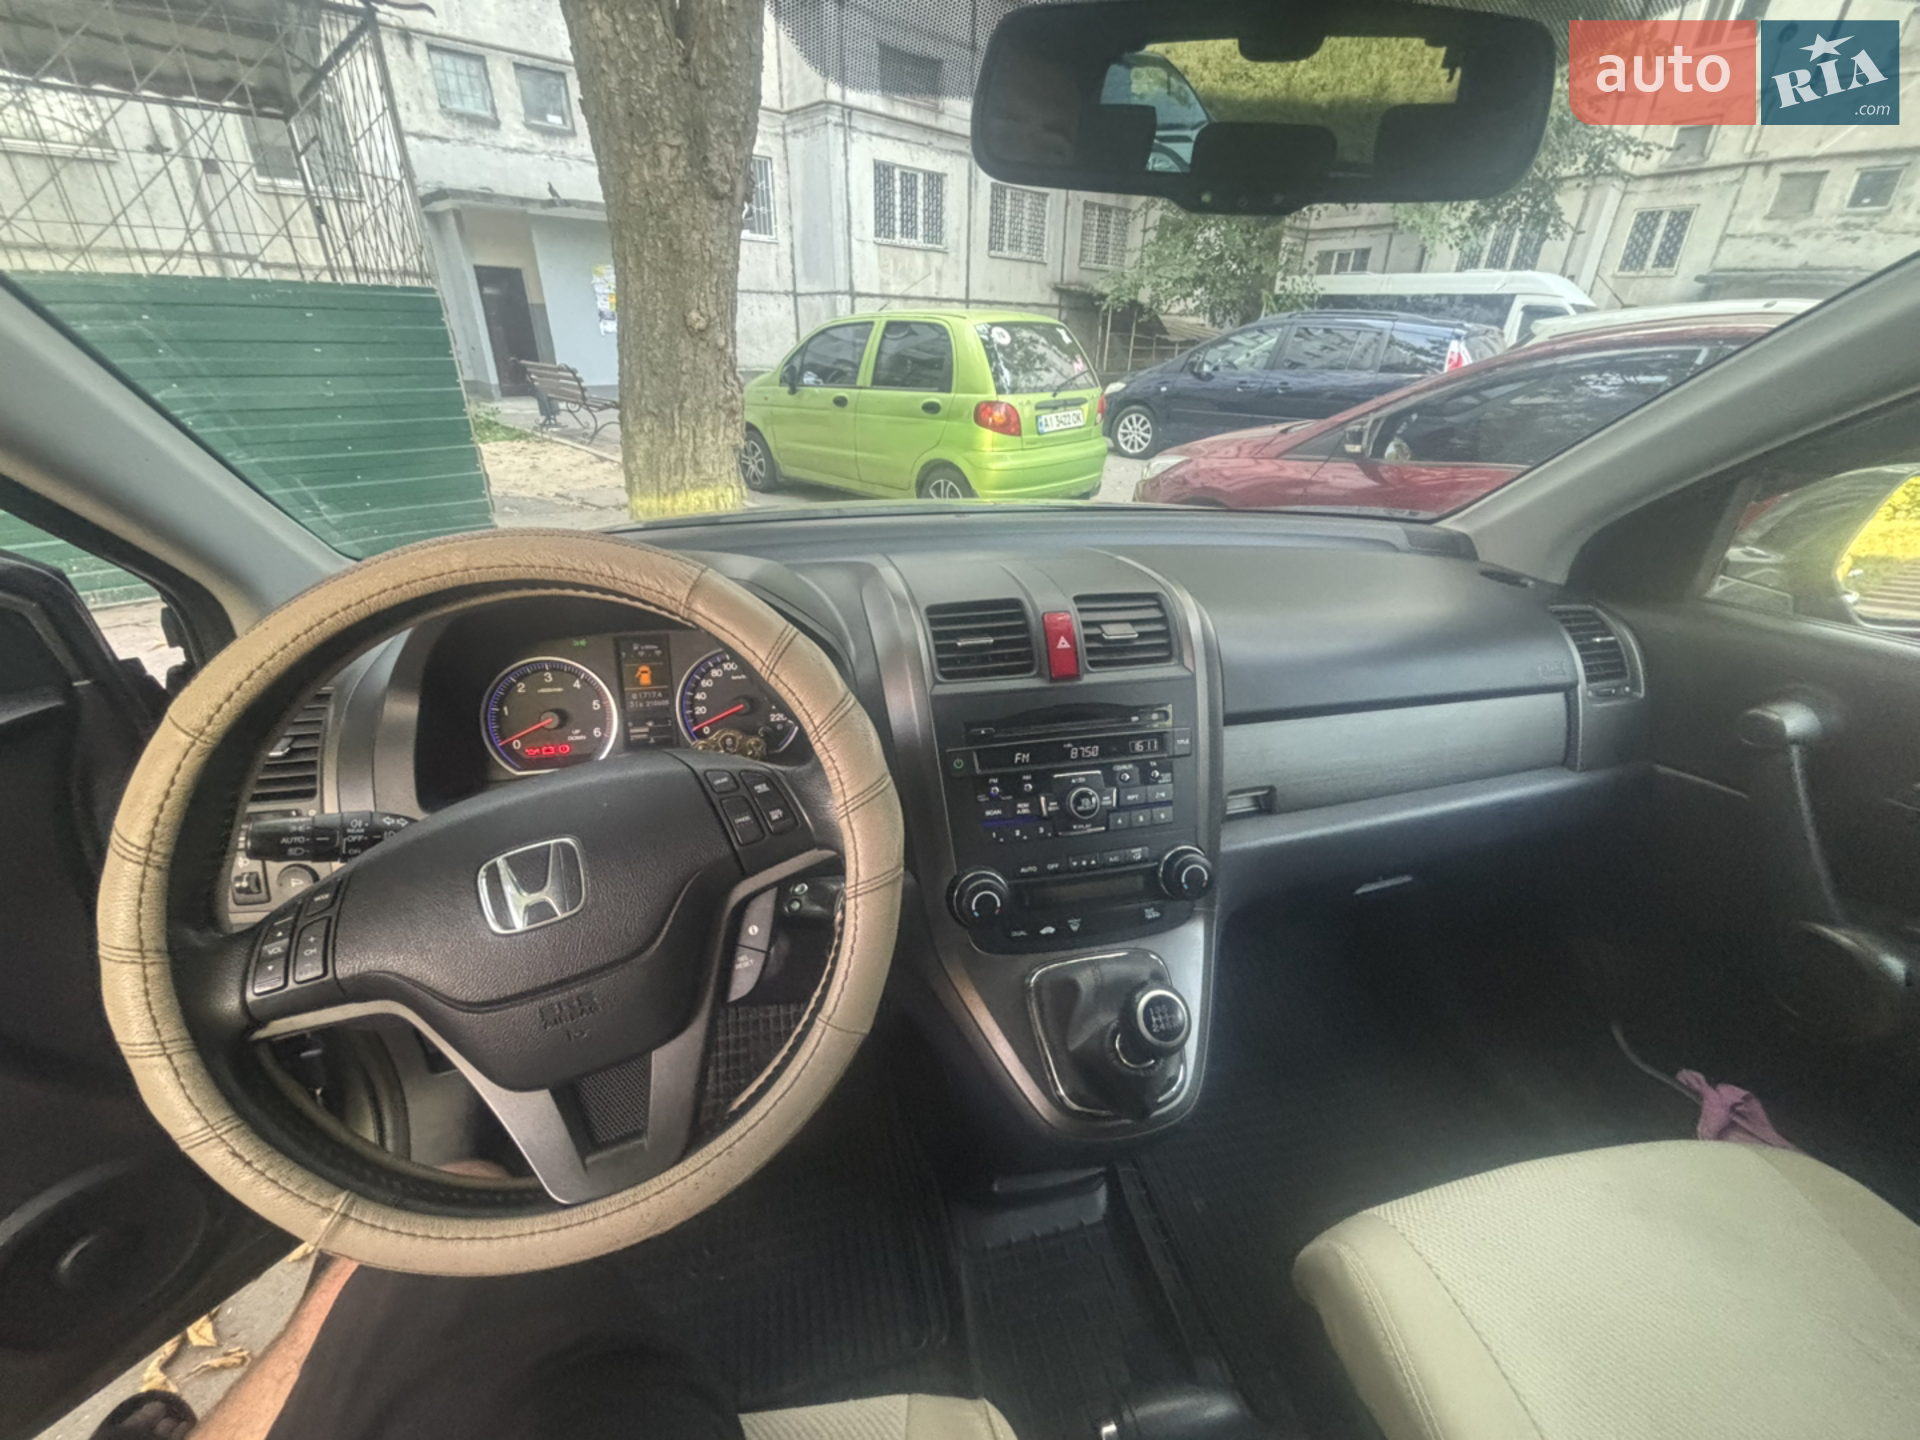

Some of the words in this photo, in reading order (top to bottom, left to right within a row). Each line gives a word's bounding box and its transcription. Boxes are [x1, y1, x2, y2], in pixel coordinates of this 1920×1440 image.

[722, 662, 738, 671] 100
[543, 671, 553, 683] 3
[710, 668, 723, 677] 80
[516, 682, 526, 693] 2
[572, 679, 581, 689] 4
[700, 678, 713, 687] 60
[694, 691, 707, 700] 40
[592, 699, 601, 710] 5
[503, 705, 509, 716] 1
[694, 706, 707, 715] 20
[592, 727, 602, 738] 6
[703, 726, 711, 734] 0
[512, 739, 521, 750] 0
[1014, 752, 1030, 764] FM
[985, 809, 1002, 817] SCAN
[280, 836, 305, 844] AUTO
[267, 946, 283, 956] VOL
[304, 947, 317, 957] CH
